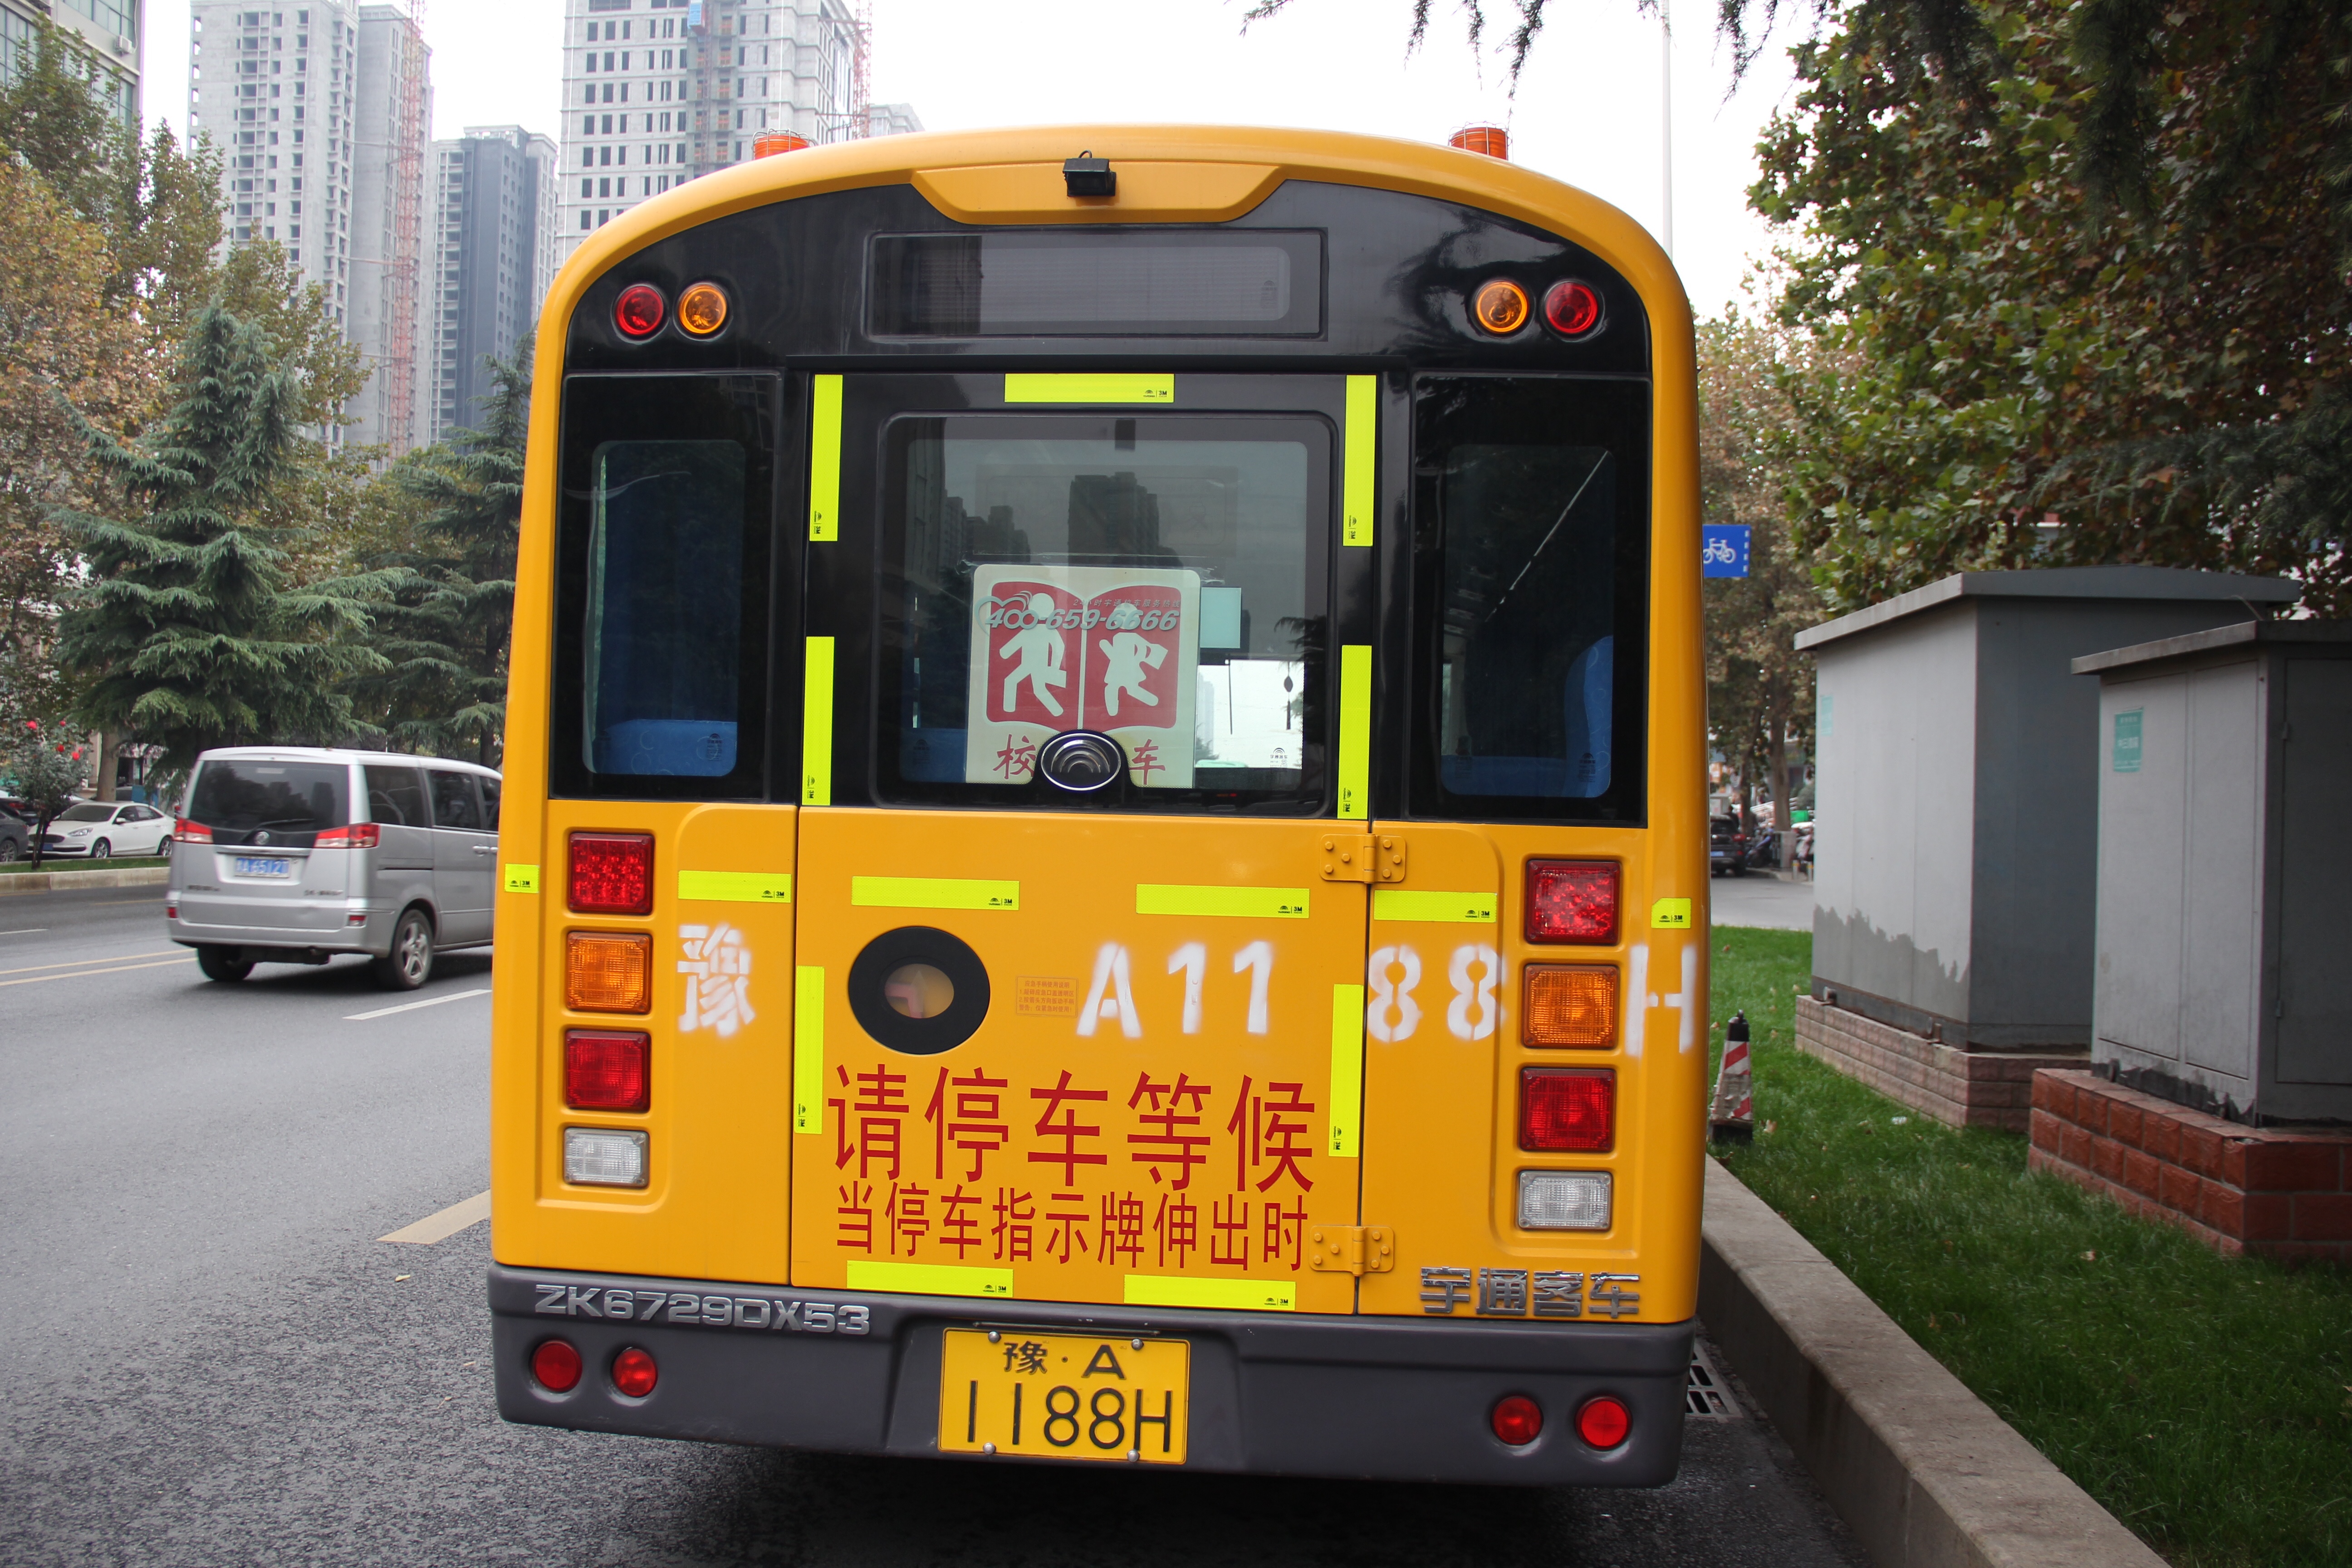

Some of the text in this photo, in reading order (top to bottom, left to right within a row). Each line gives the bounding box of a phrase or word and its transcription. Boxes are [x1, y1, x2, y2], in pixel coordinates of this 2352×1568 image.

[816, 525, 821, 534] 3M
[1351, 531, 1356, 539] 3M
[985, 608, 1180, 631] 400-659-6666
[809, 790, 814, 799] 3M
[1345, 804, 1351, 812] 3M
[677, 923, 755, 1037] 豫
[1024, 980, 1070, 988] 应急手柄使用说明
[800, 1118, 805, 1127] 3M
[828, 1064, 1315, 1193] 请停车等候
[1335, 1142, 1341, 1150] 3M
[837, 1181, 1308, 1272] 当停车指示牌伸出时
[1419, 1266, 1640, 1318] 宇通客车
[534, 1284, 871, 1335] ZK6729DX53
[967, 1379, 1172, 1453] 1188H
